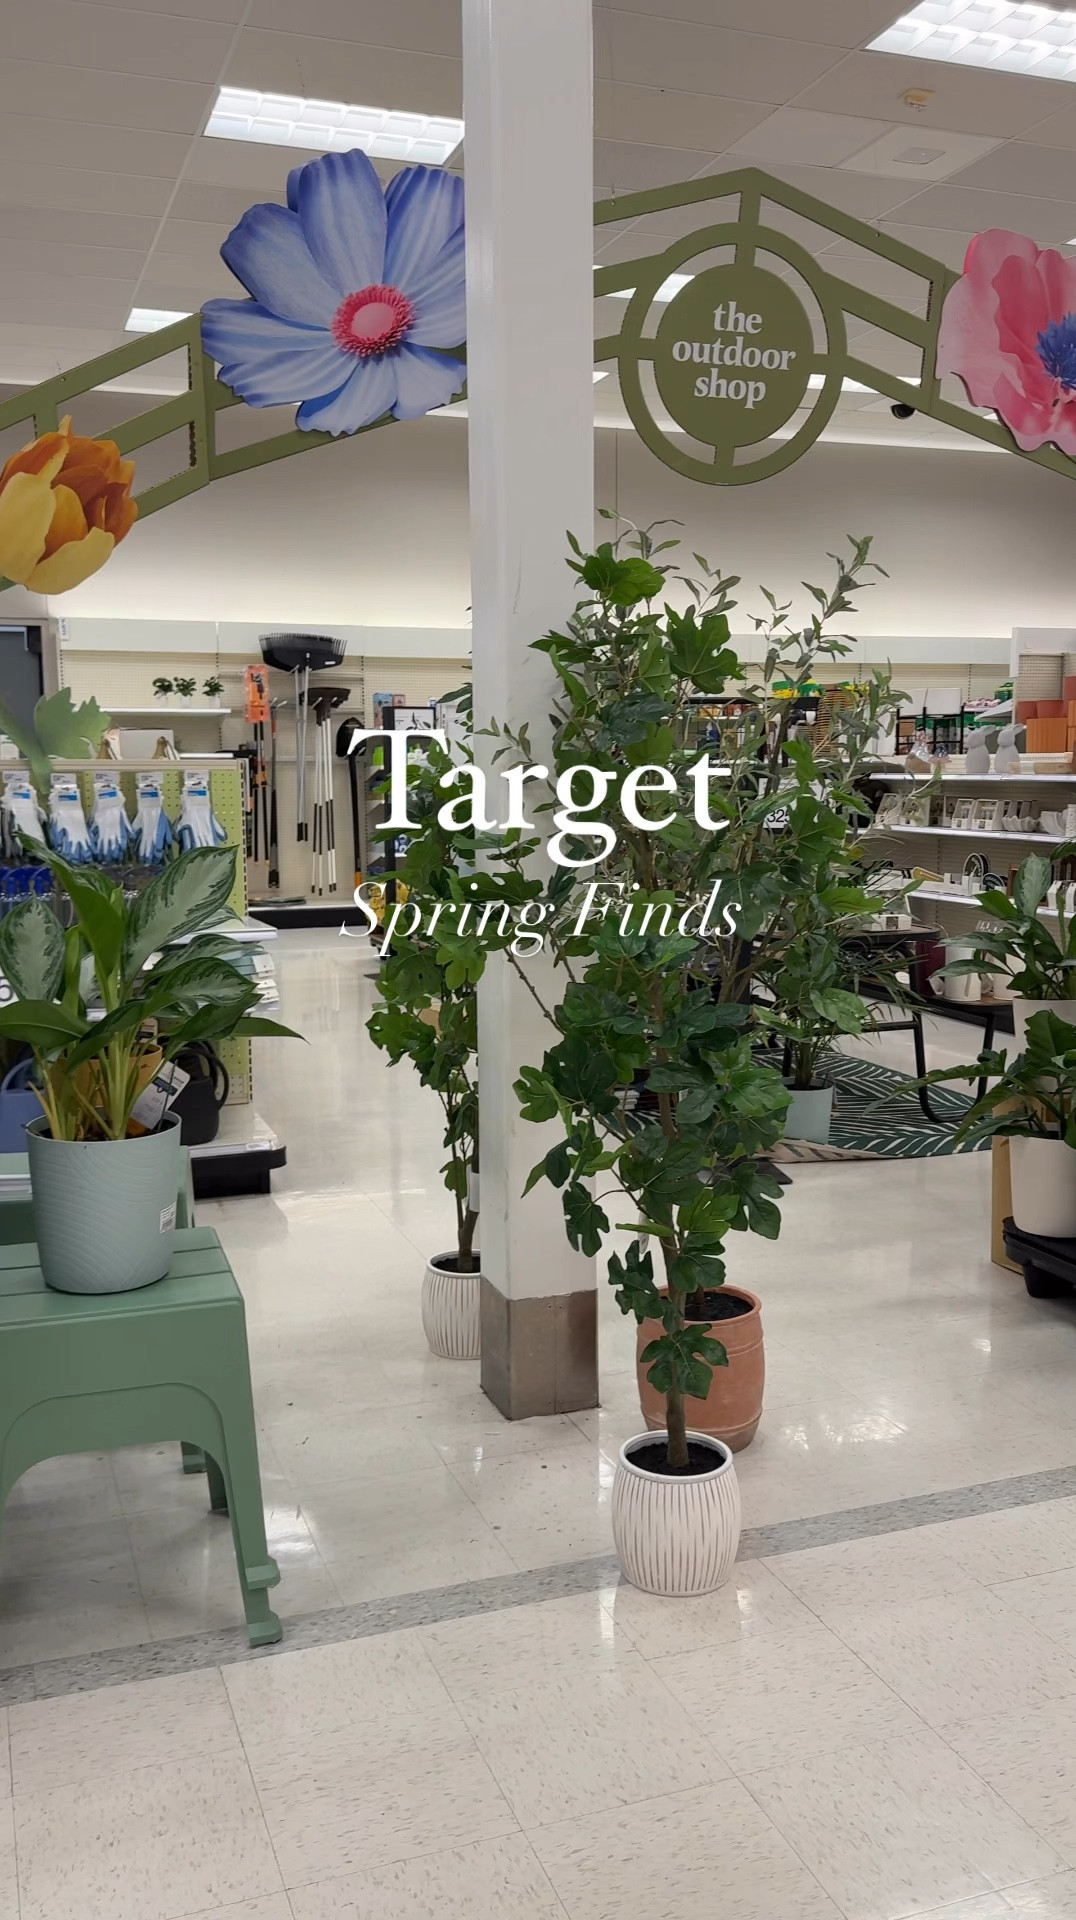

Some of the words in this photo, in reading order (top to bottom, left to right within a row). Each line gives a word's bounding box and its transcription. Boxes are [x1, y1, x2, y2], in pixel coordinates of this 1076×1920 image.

[713, 301, 762, 334] the
[672, 336, 797, 370] outdoor
[693, 367, 766, 409] shop
